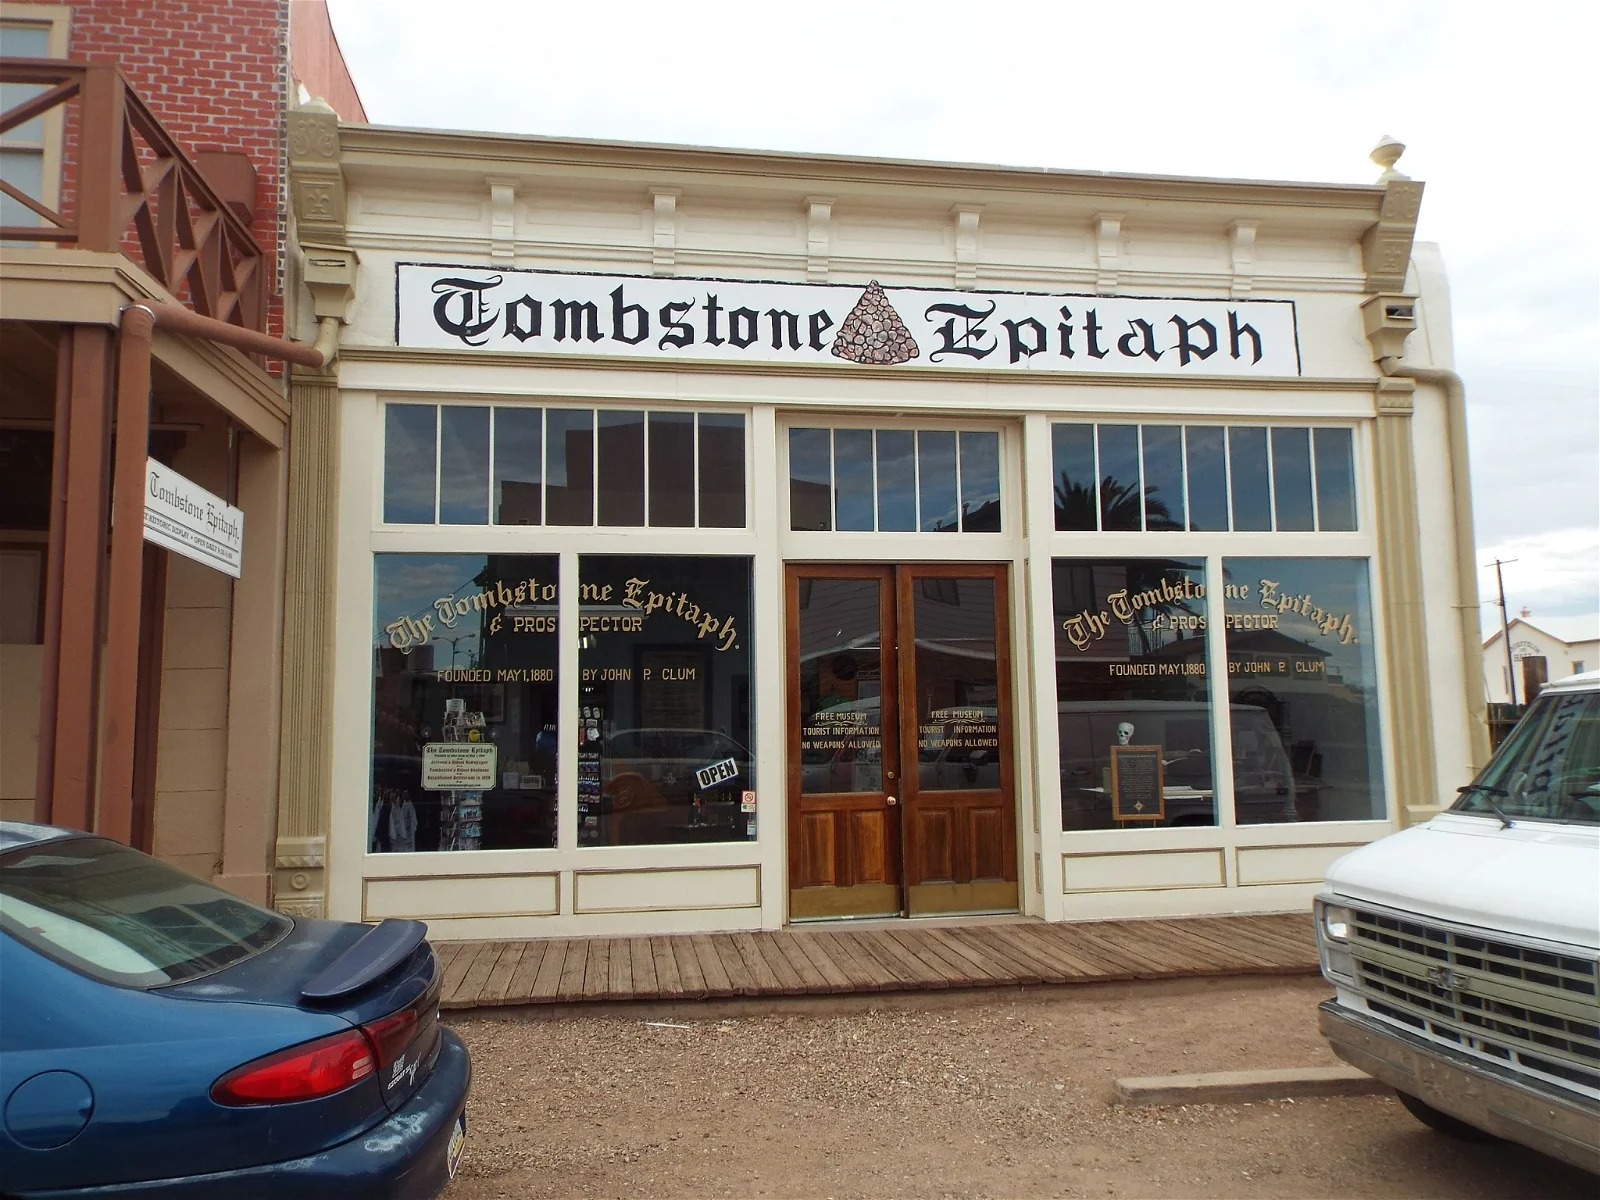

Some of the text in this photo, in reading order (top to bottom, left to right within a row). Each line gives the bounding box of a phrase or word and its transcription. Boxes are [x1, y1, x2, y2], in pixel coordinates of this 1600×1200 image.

[430, 274, 1264, 367] Tombstone Epitaph
[150, 471, 204, 521] Tombstone
[384, 576, 740, 655] The Tombstone Epitaph.
[1062, 610, 1111, 651] The
[1107, 575, 1250, 626] Tombstone
[513, 616, 643, 633] PROSPECTOR
[1169, 614, 1279, 630] PROSPECTOR
[437, 669, 491, 682] FOUNDED
[582, 668, 597, 681] BY
[600, 668, 631, 681] JOHN
[662, 668, 696, 680] CLUM
[1109, 663, 1156, 676] FOUNDED
[1228, 661, 1242, 673] BY
[1244, 661, 1271, 673] JOHN
[1295, 661, 1326, 673] CLUM
[815, 712, 867, 721] FREE MUSEUM
[931, 710, 984, 719] FREE MUSEUM
[802, 726, 880, 736] TOURIST INFORMATION
[918, 725, 997, 734] TOURIST INFORMATION
[801, 739, 882, 749] NO WEAPONS ALLOWED
[918, 738, 998, 748] NO WEAPONS ALLOWED
[700, 760, 736, 786] OPEN
